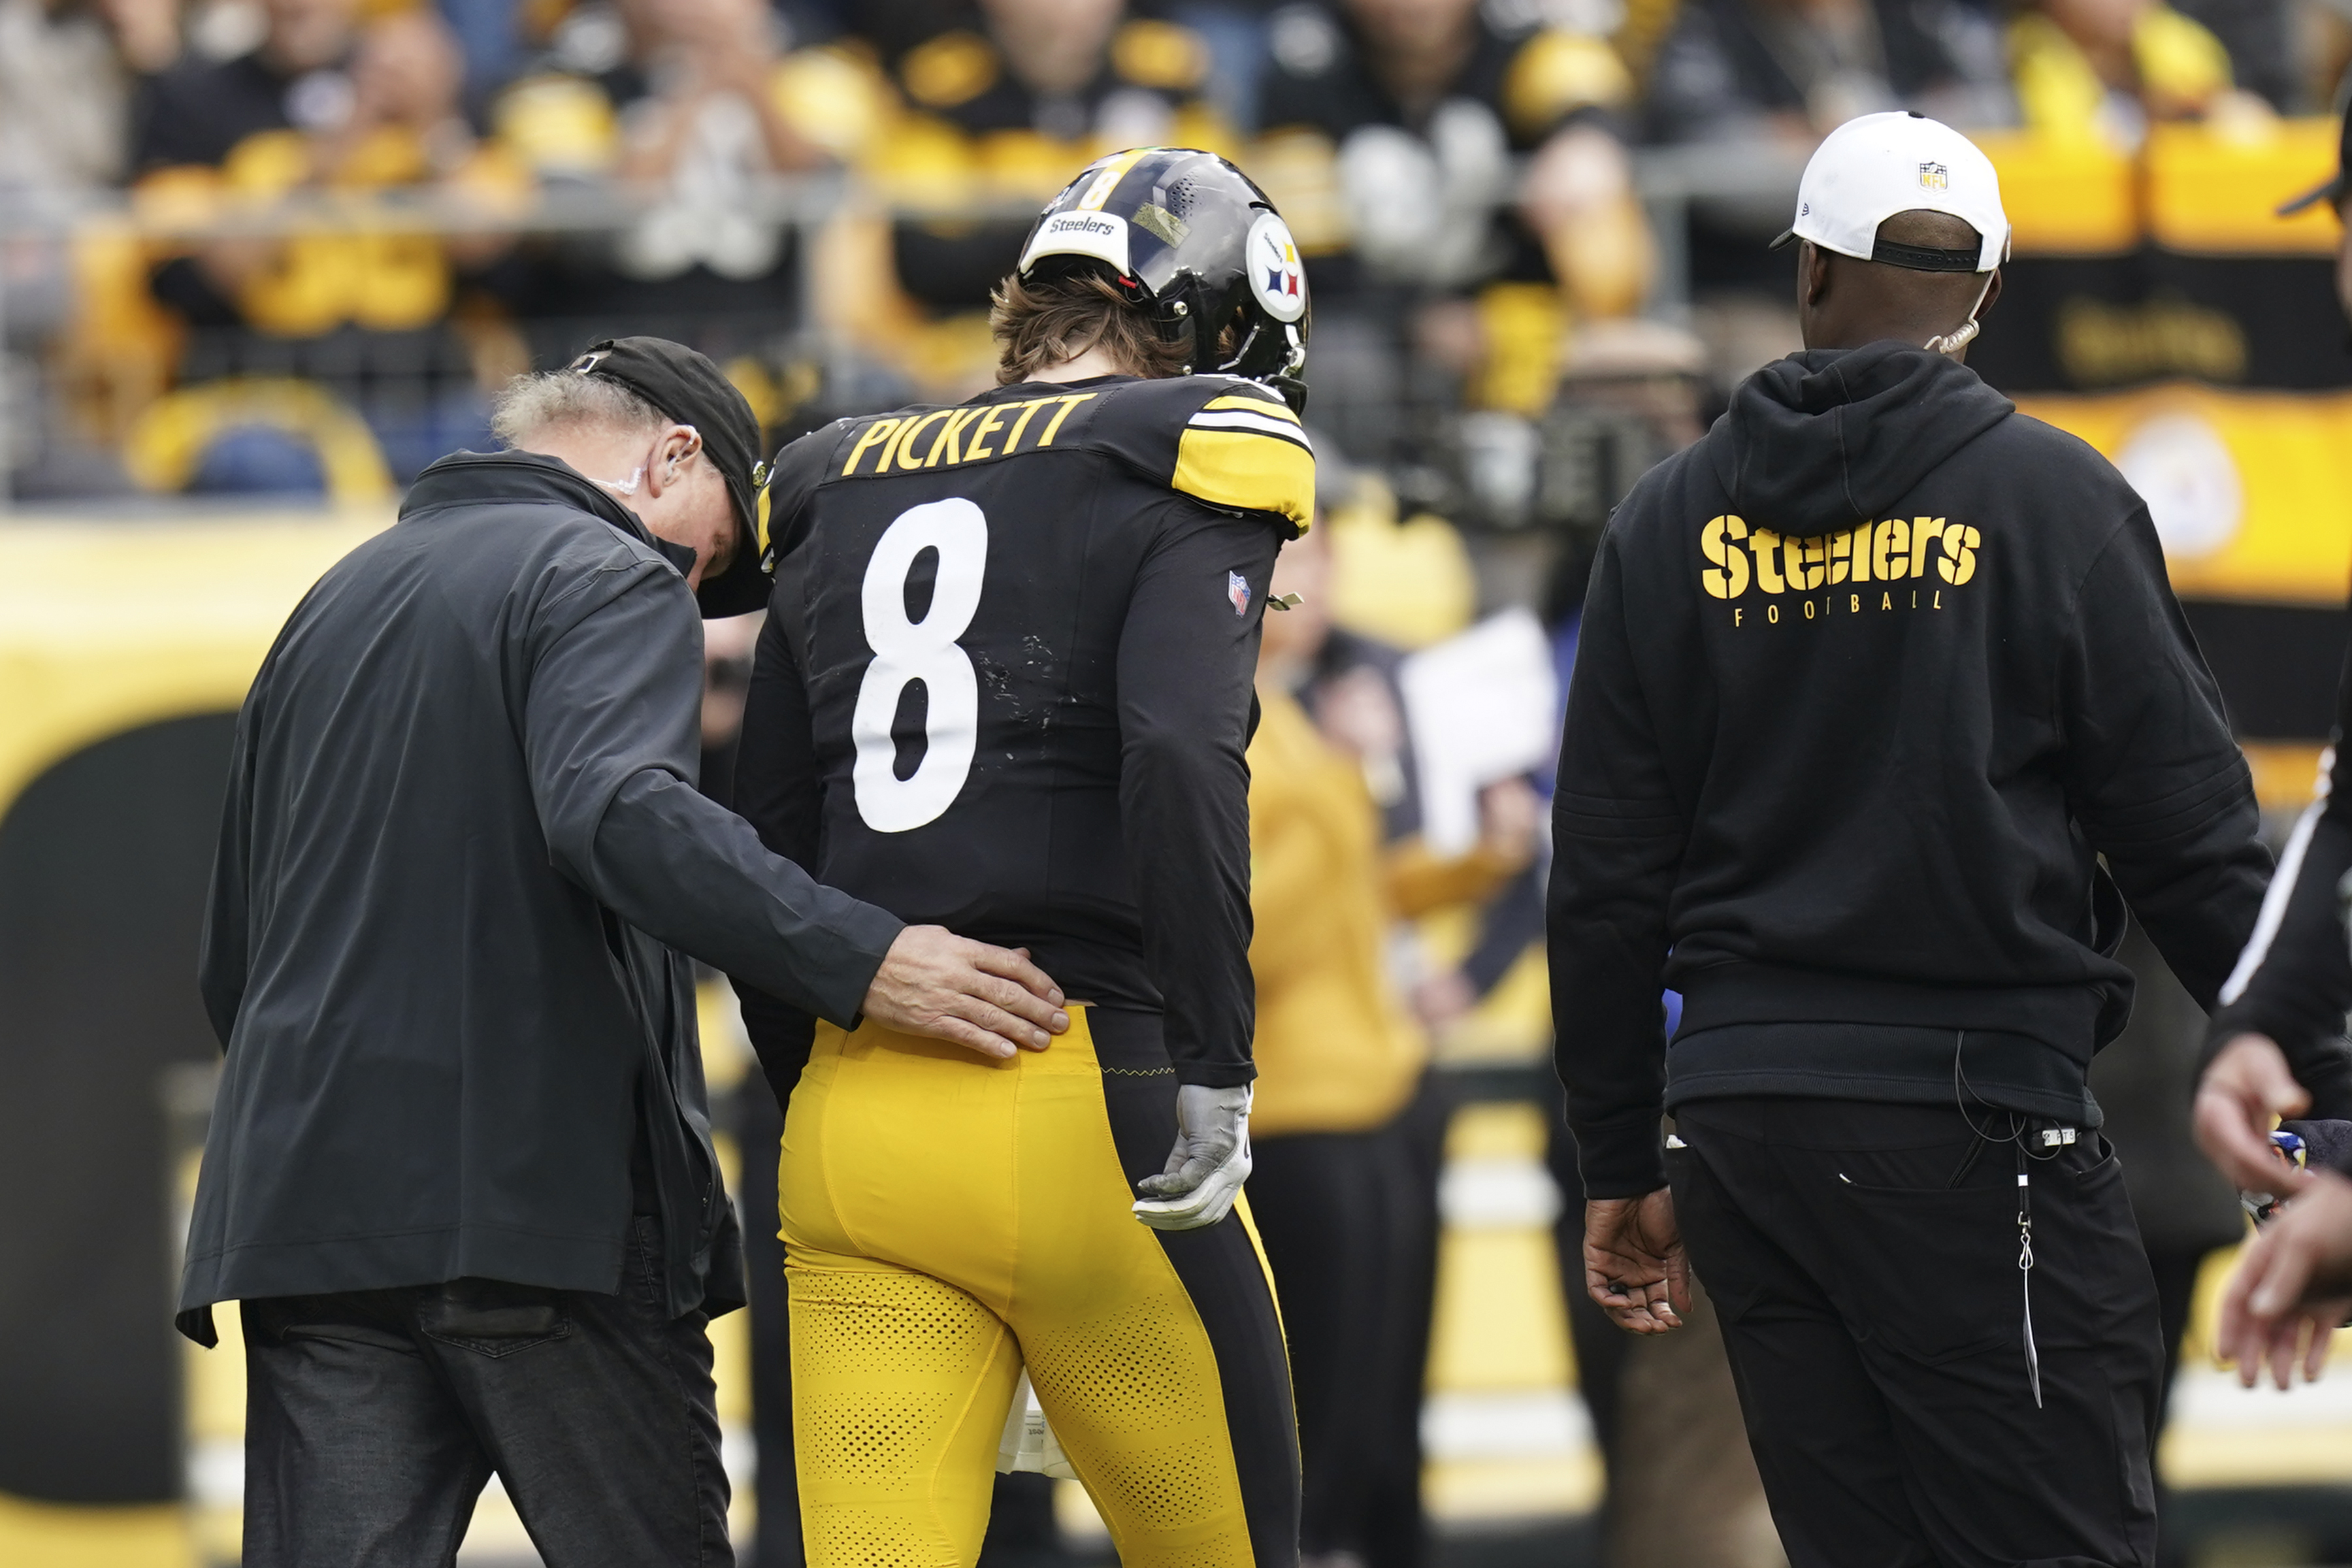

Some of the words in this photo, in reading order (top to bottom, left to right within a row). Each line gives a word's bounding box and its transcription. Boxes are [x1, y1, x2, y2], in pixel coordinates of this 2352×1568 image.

[1080, 171, 1121, 210] 8
[1923, 174, 1945, 189] NFL
[1050, 216, 1114, 235] Steelers
[841, 393, 1098, 476] PICKETT
[1701, 514, 1982, 599] Steelers
[852, 497, 988, 833] 8
